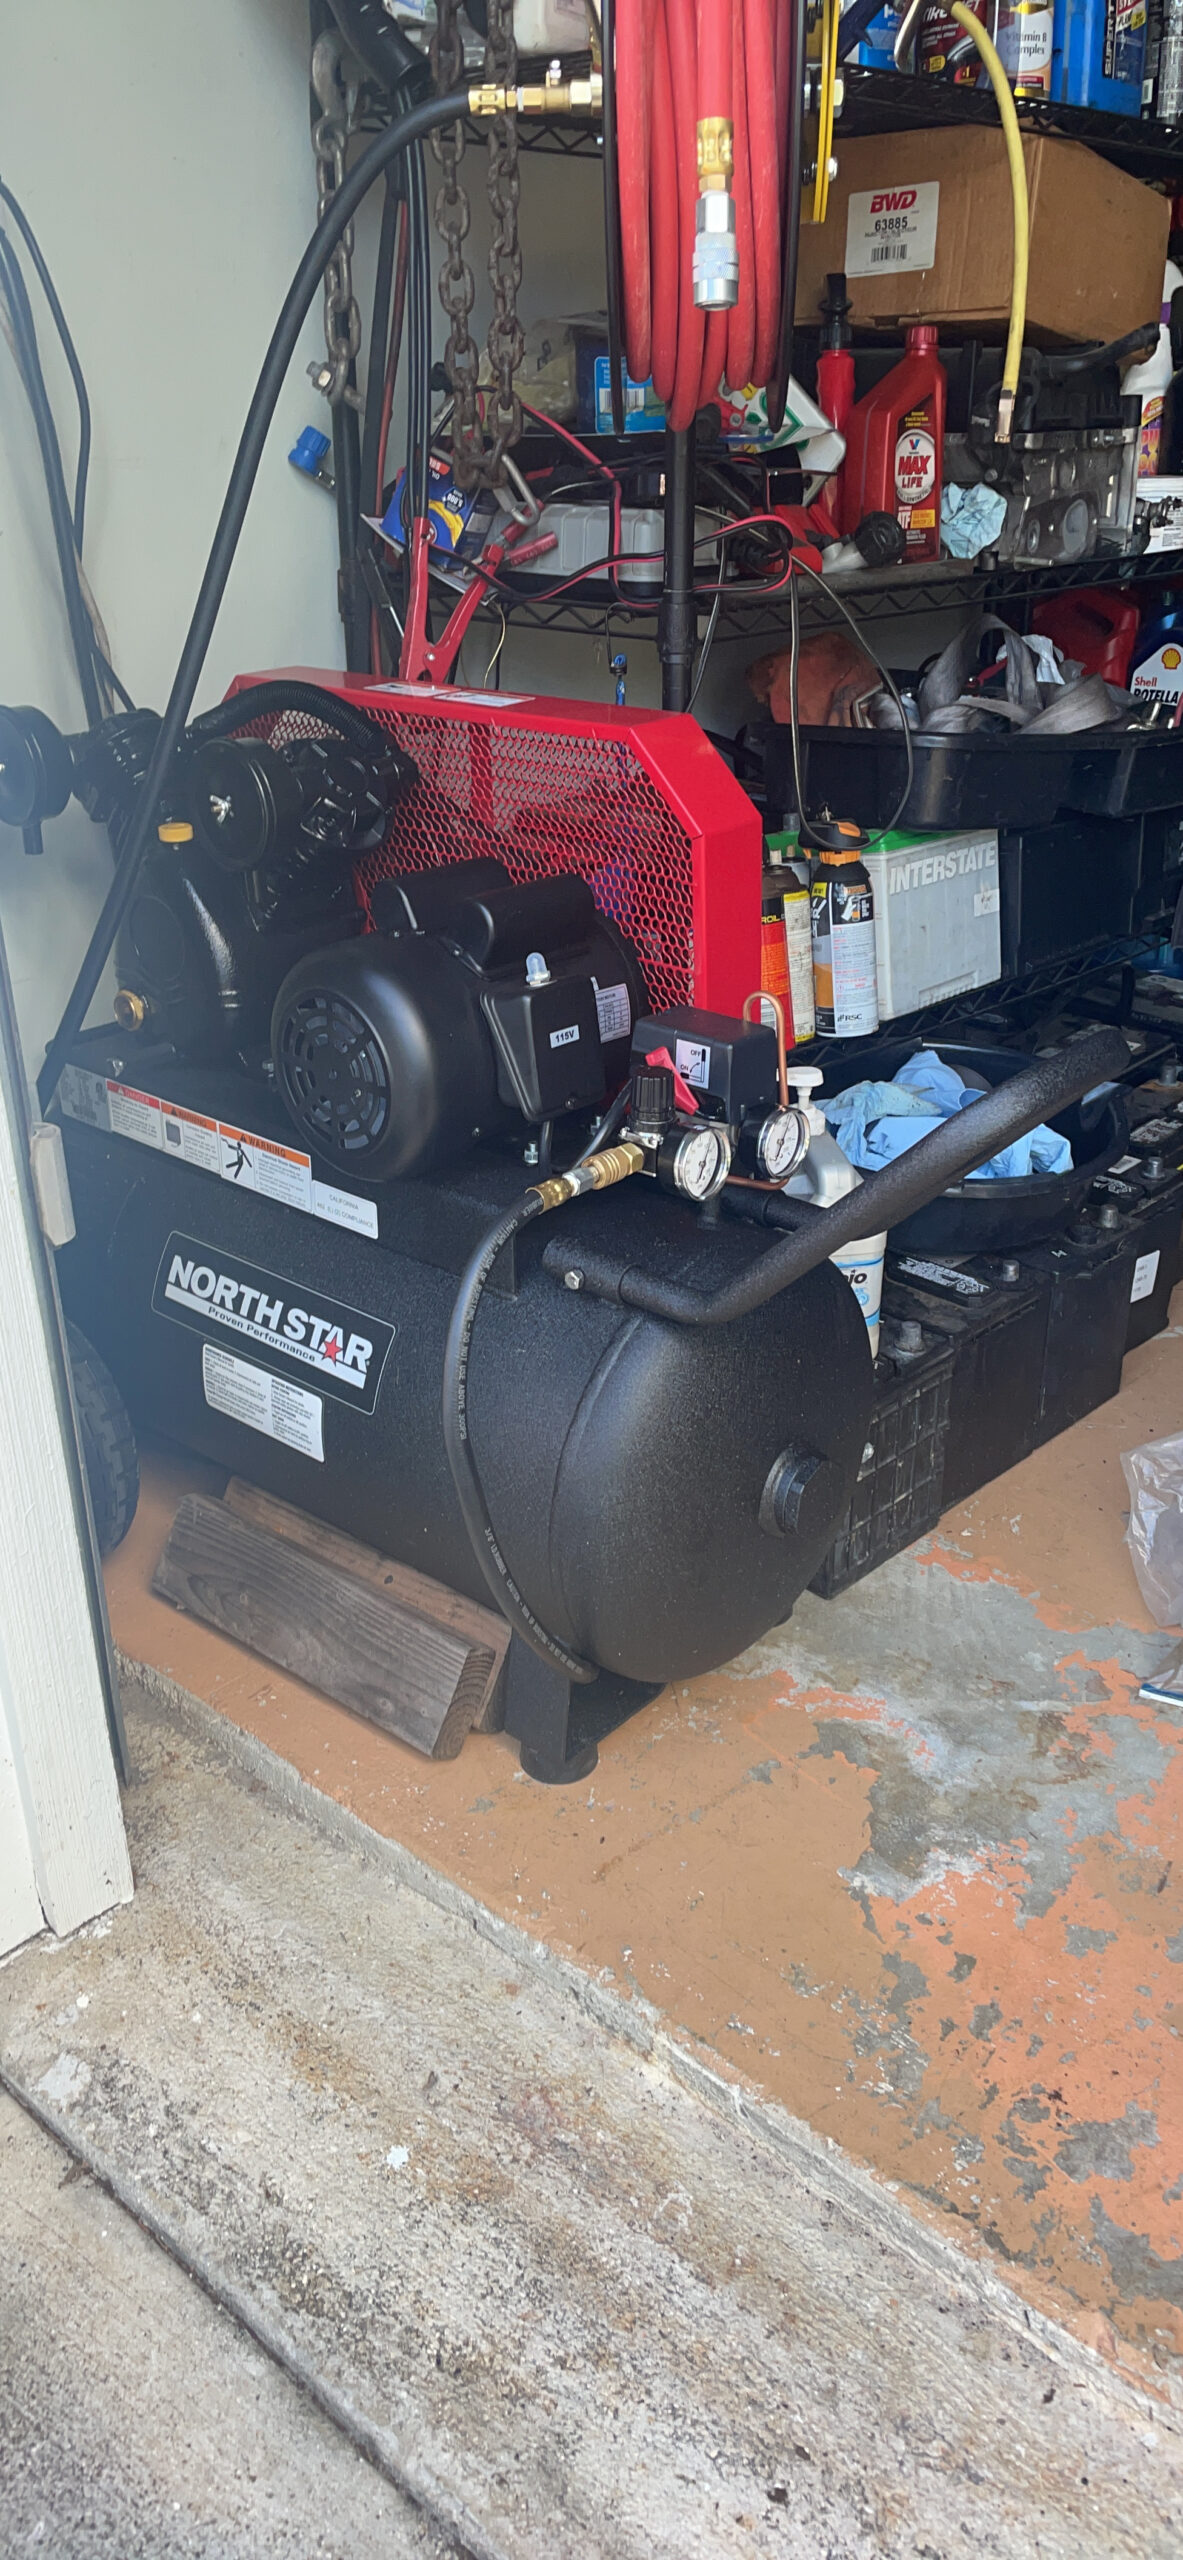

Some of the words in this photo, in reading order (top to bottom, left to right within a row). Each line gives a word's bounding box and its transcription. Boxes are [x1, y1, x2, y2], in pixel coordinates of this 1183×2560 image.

[1006, 30, 1041, 43] Vitamin
[870, 190, 917, 213] BWD
[875, 216, 908, 233] 63885
[898, 455, 931, 476] MAX
[902, 477, 923, 488] LIFE
[1134, 676, 1157, 687] Shell
[1133, 688, 1179, 704] ROTELLA
[890, 841, 996, 895] INTERSTATE
[555, 1030, 575, 1043] 115V
[248, 1135, 286, 1158] WARNING
[329, 1194, 359, 1210] CALIFORNIA
[167, 1254, 284, 1331] NORTH
[283, 1308, 374, 1373] STAR
[208, 1305, 243, 1330] Proven
[246, 1323, 316, 1362] Performance
[458, 1365, 467, 1381] USE
[457, 1384, 466, 1410] ABOVE
